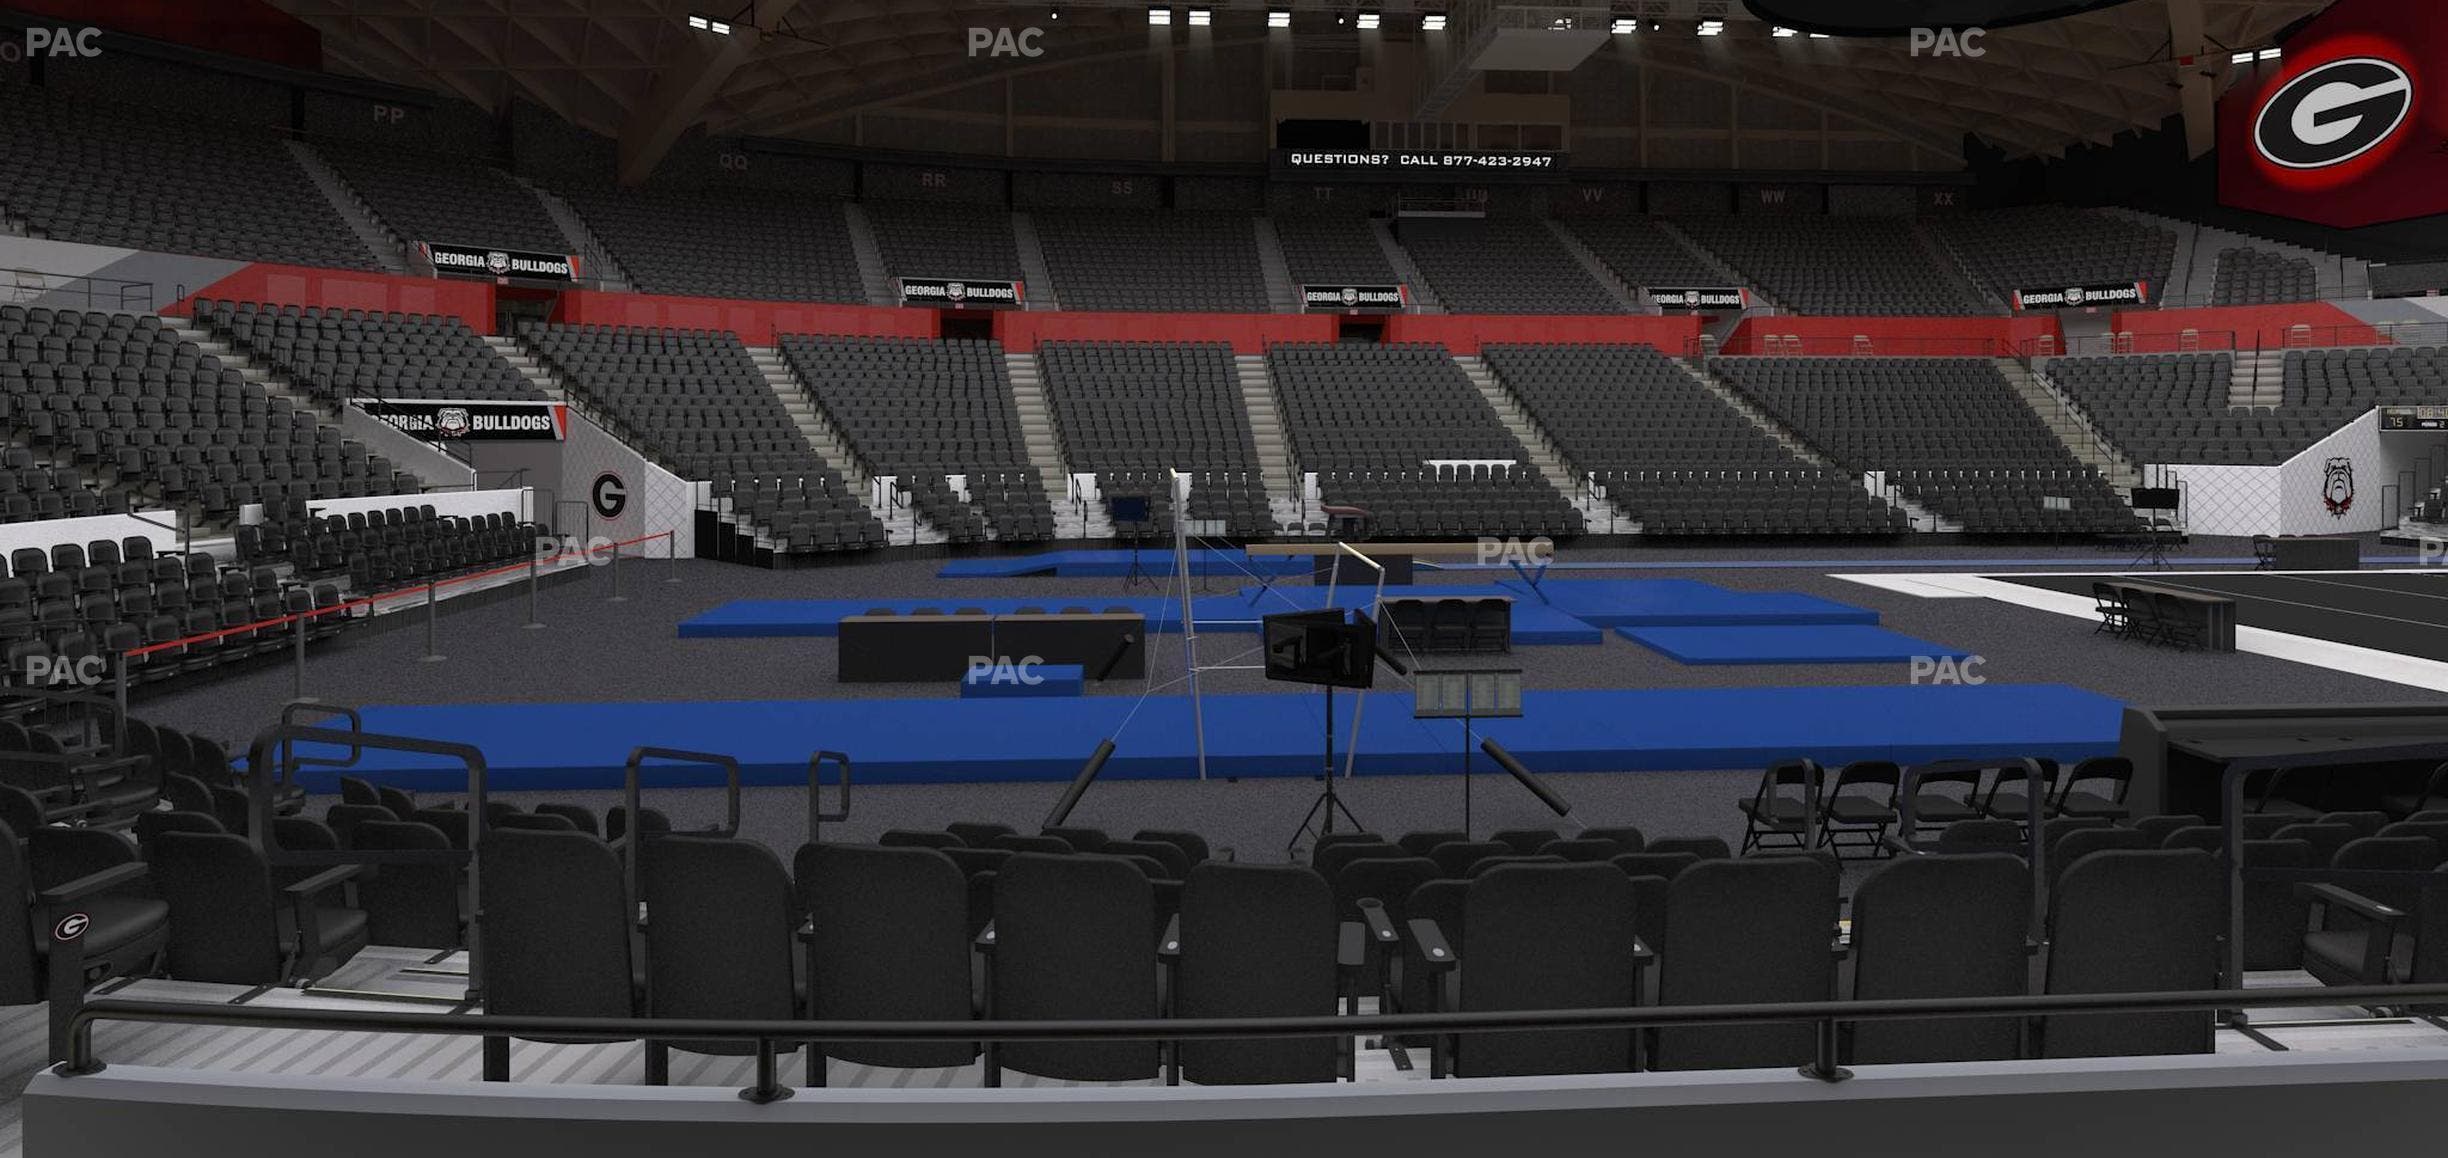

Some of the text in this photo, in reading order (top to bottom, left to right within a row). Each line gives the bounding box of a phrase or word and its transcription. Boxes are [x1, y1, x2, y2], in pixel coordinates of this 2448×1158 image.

[373, 104, 404, 124] PP
[1291, 153, 1552, 167] QUESTIONS? CALL 877-423-2947
[920, 172, 947, 188] RR
[434, 251, 569, 275] GEORGIA BULLDOGS
[904, 284, 1014, 299] GEORGIA BULLDOGS
[1307, 291, 1399, 303] GEORGIA BULLDOGS
[1700, 294, 1740, 305] BULLDOGS
[2023, 288, 2137, 305] GEORGIA BULLDOGS
[472, 414, 551, 431] BULLDOGS
[592, 473, 626, 518] G
